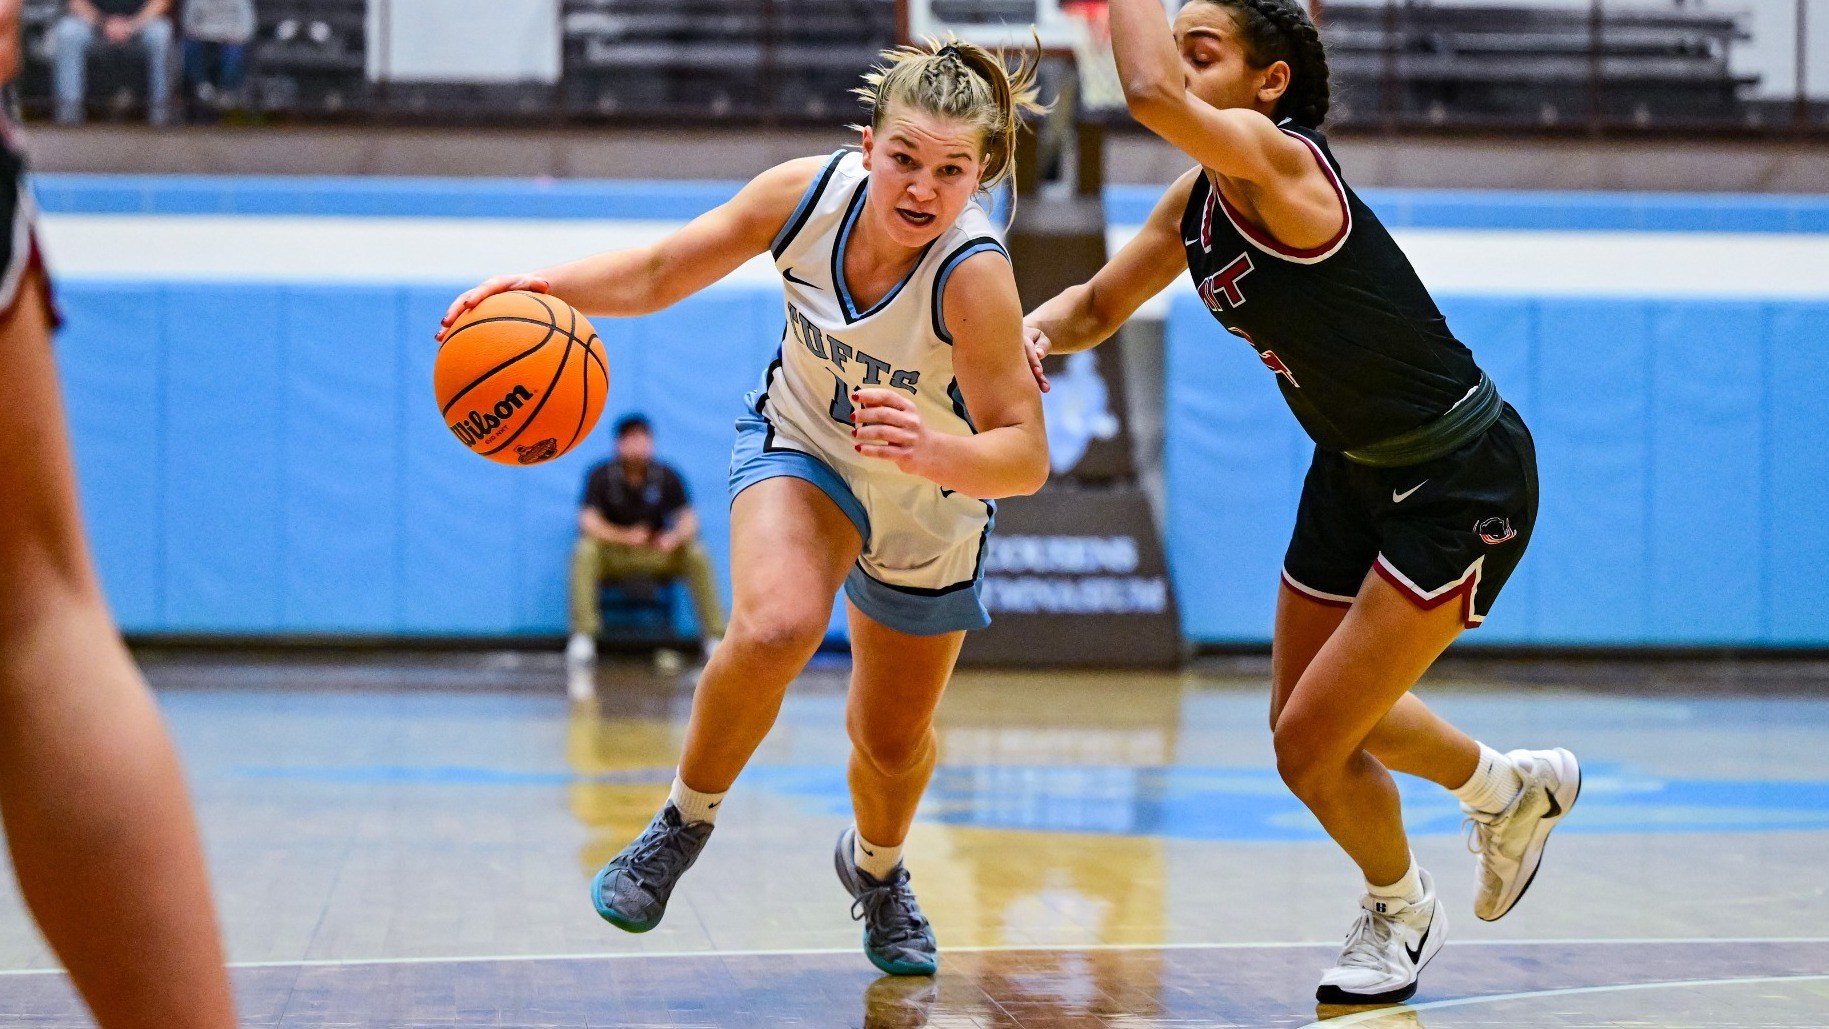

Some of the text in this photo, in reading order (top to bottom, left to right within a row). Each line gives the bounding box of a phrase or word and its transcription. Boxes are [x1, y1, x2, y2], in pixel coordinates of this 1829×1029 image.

[788, 301, 921, 396] TUFTS
[449, 384, 534, 448] Wilson
[825, 366, 867, 430] 1
